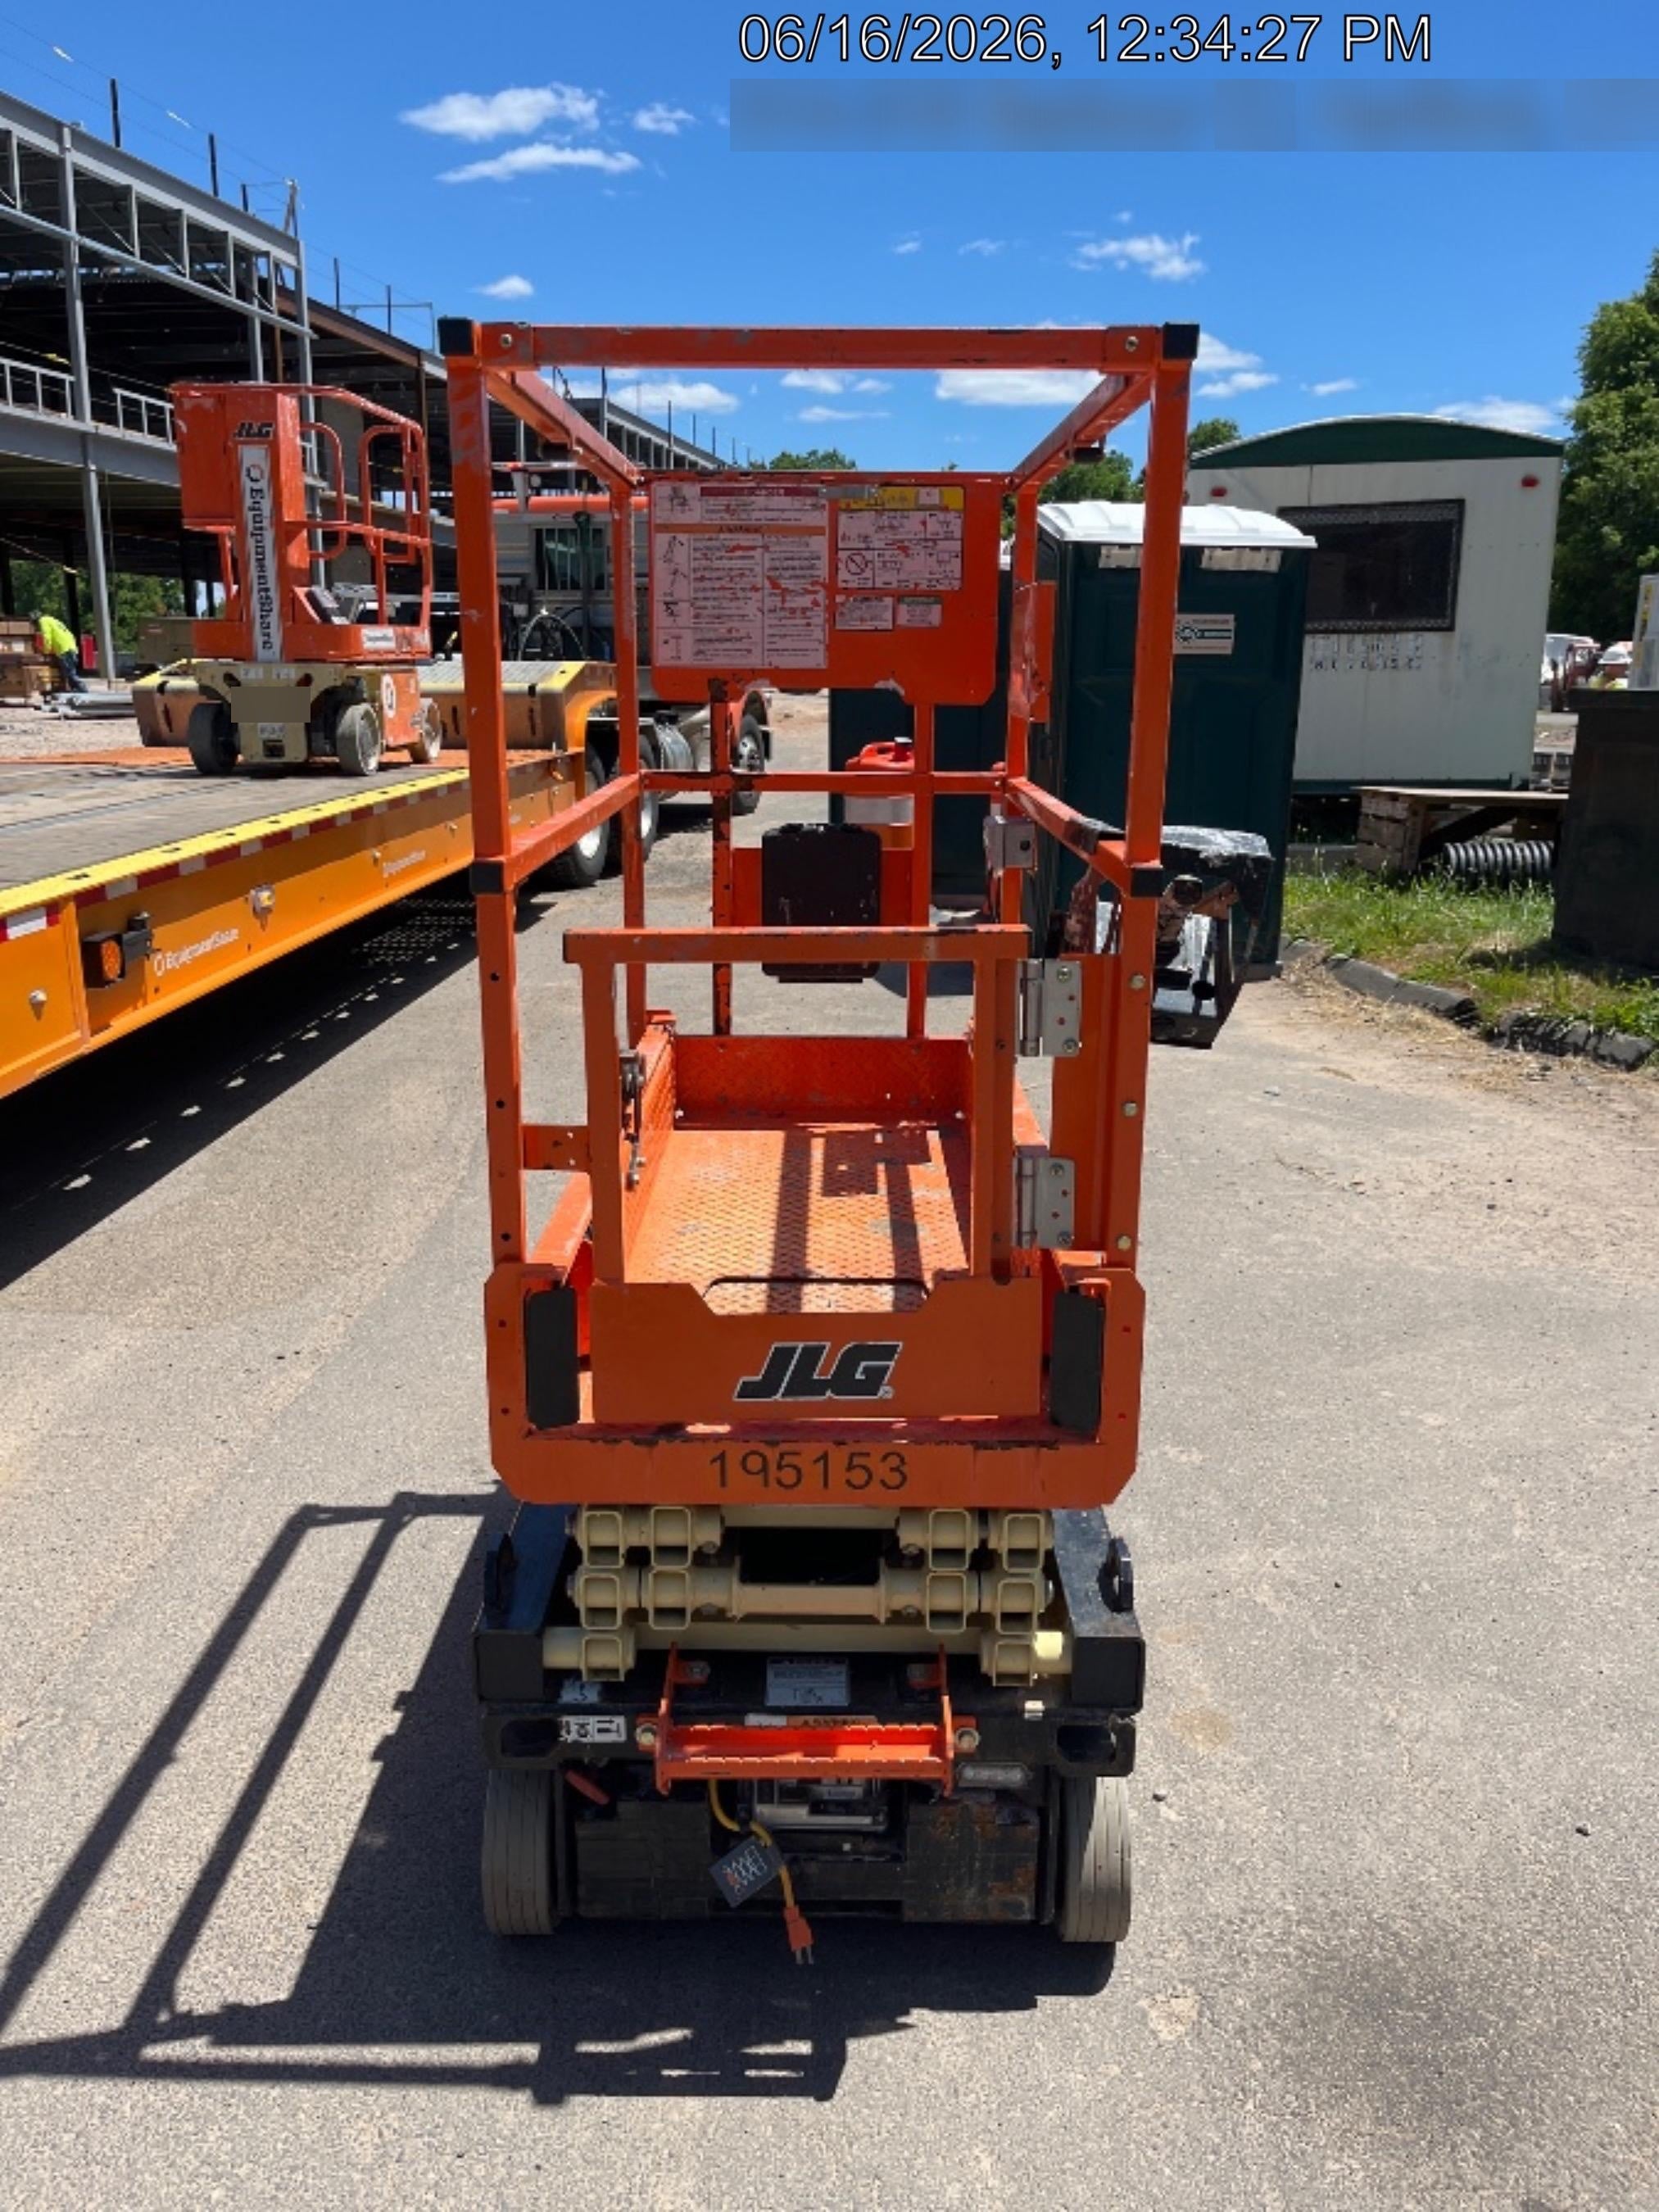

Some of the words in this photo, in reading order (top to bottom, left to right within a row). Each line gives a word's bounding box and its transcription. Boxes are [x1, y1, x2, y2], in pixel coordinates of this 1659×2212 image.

[233, 422, 274, 439] JLG
[249, 487, 274, 650] EquipmentShare
[732, 1341, 903, 1401] JLG
[709, 1449, 908, 1489] 195153
